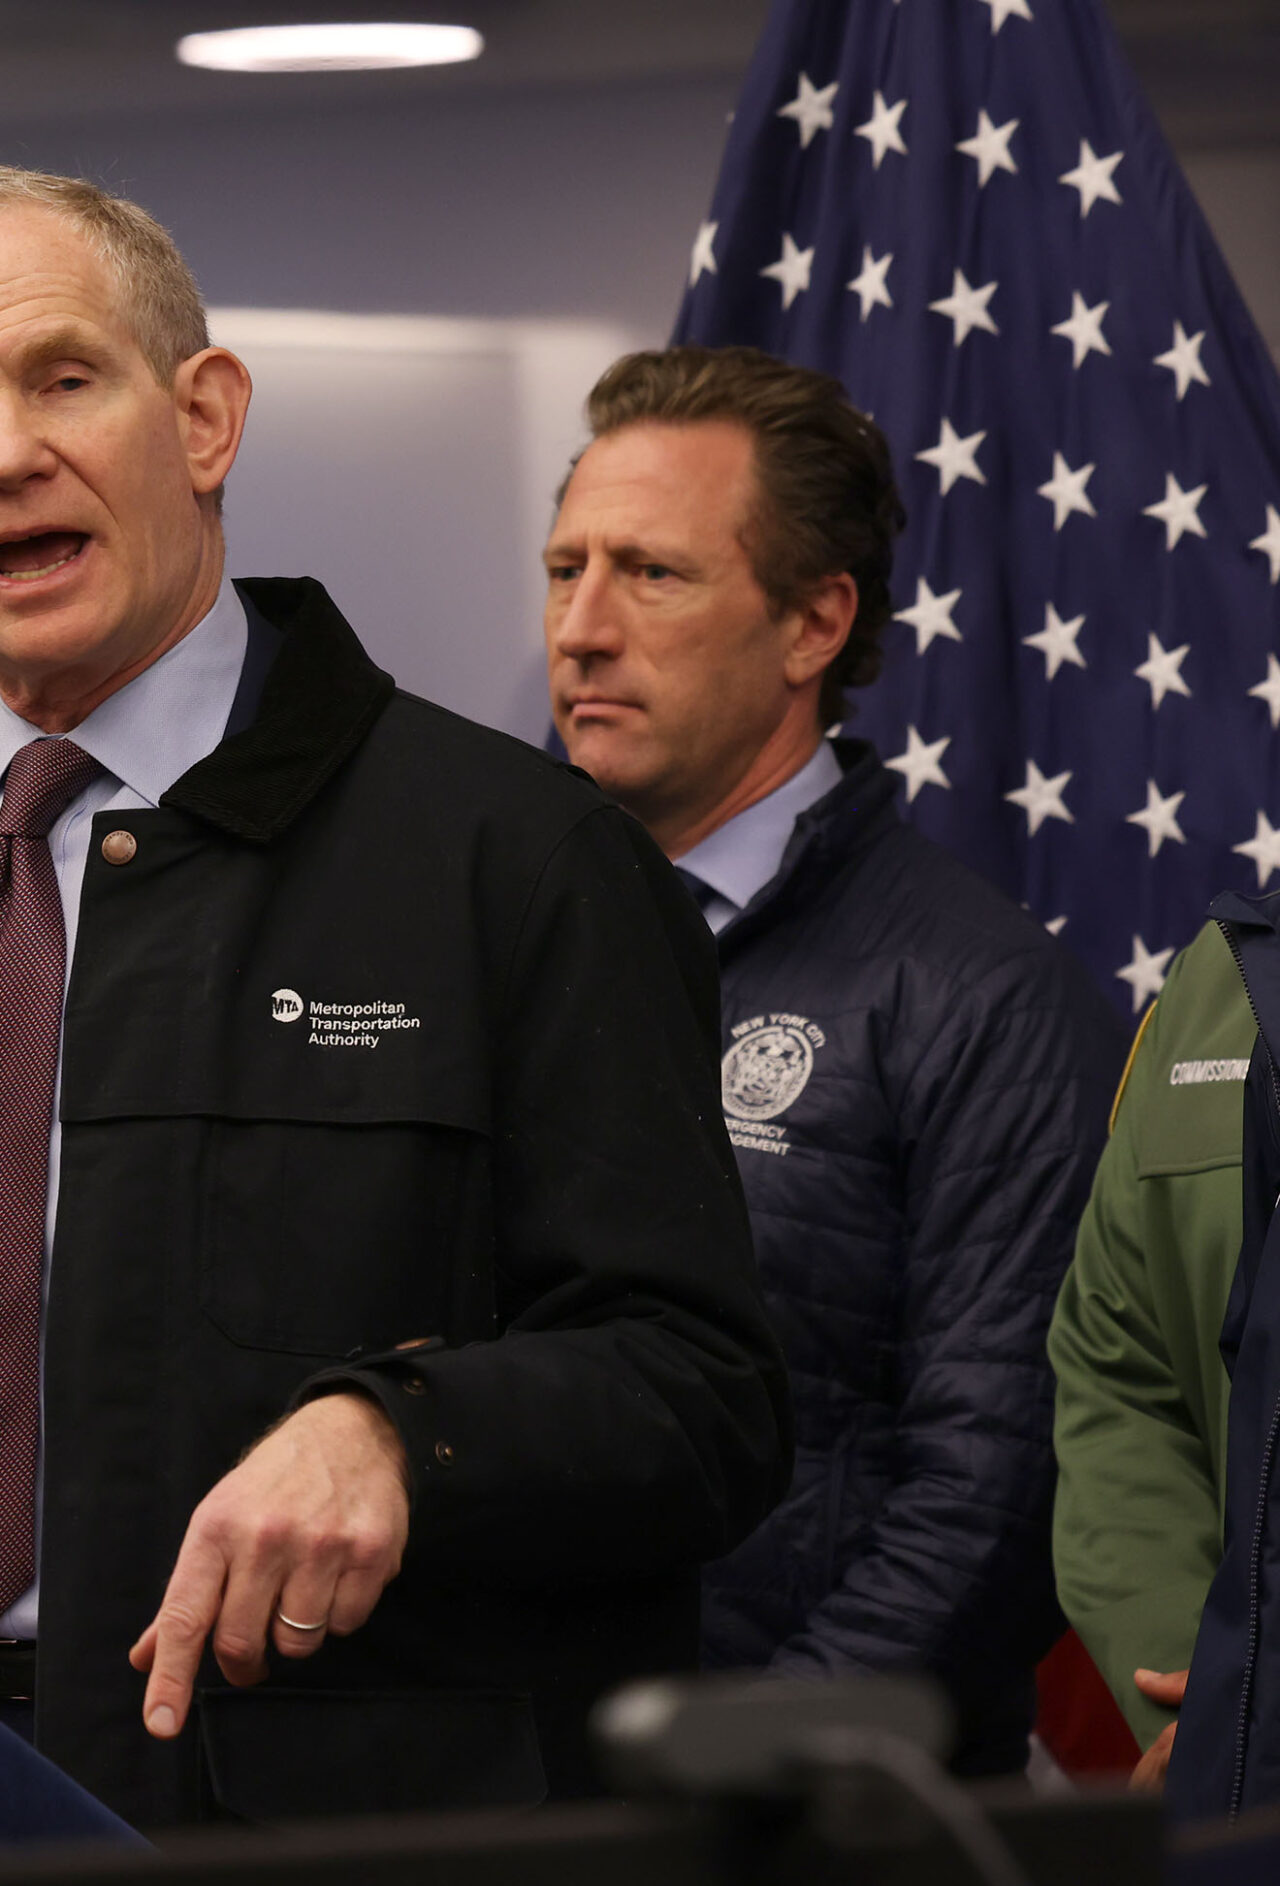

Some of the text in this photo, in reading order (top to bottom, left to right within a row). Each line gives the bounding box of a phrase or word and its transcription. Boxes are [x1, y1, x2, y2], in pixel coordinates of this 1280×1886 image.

[309, 1000, 405, 1018] Metropolitan
[308, 1015, 421, 1034] Transportation
[730, 1012, 827, 1049] NEW YORK CITY
[308, 1032, 380, 1048] Authority
[1170, 1059, 1251, 1085] COMMISSIONE
[724, 1117, 787, 1140] ERGENCY
[728, 1132, 791, 1157] GEMENT
